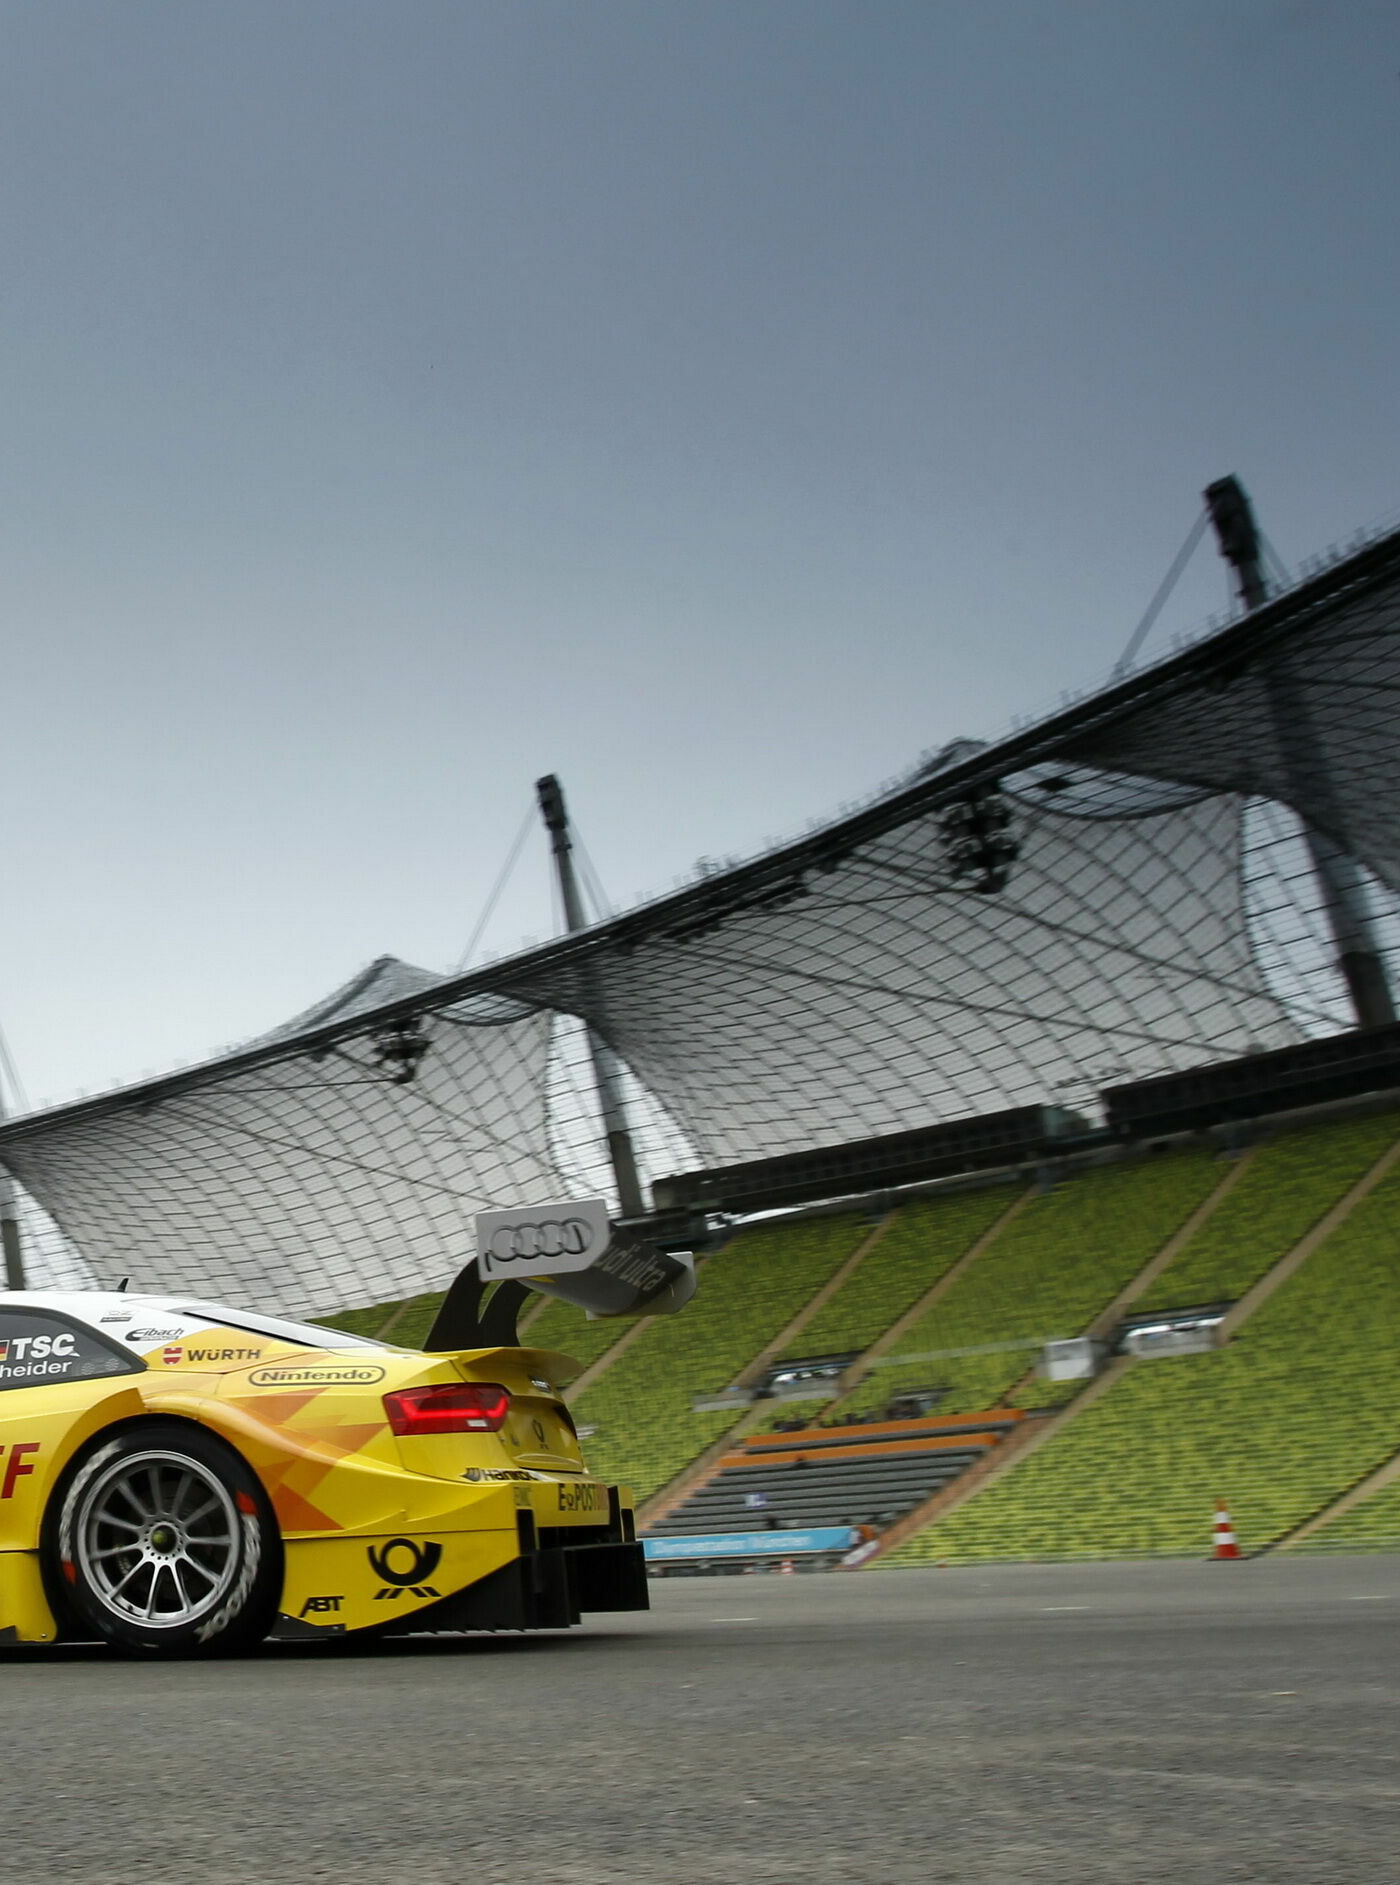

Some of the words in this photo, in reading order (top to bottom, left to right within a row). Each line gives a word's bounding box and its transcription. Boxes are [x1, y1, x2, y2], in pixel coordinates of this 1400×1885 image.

[125, 1327, 184, 1341] Eibach
[11, 1333, 77, 1360] TSC
[188, 1349, 261, 1361] WÜRTH
[260, 1369, 373, 1382] Nintendo
[299, 1595, 345, 1618] ABT
